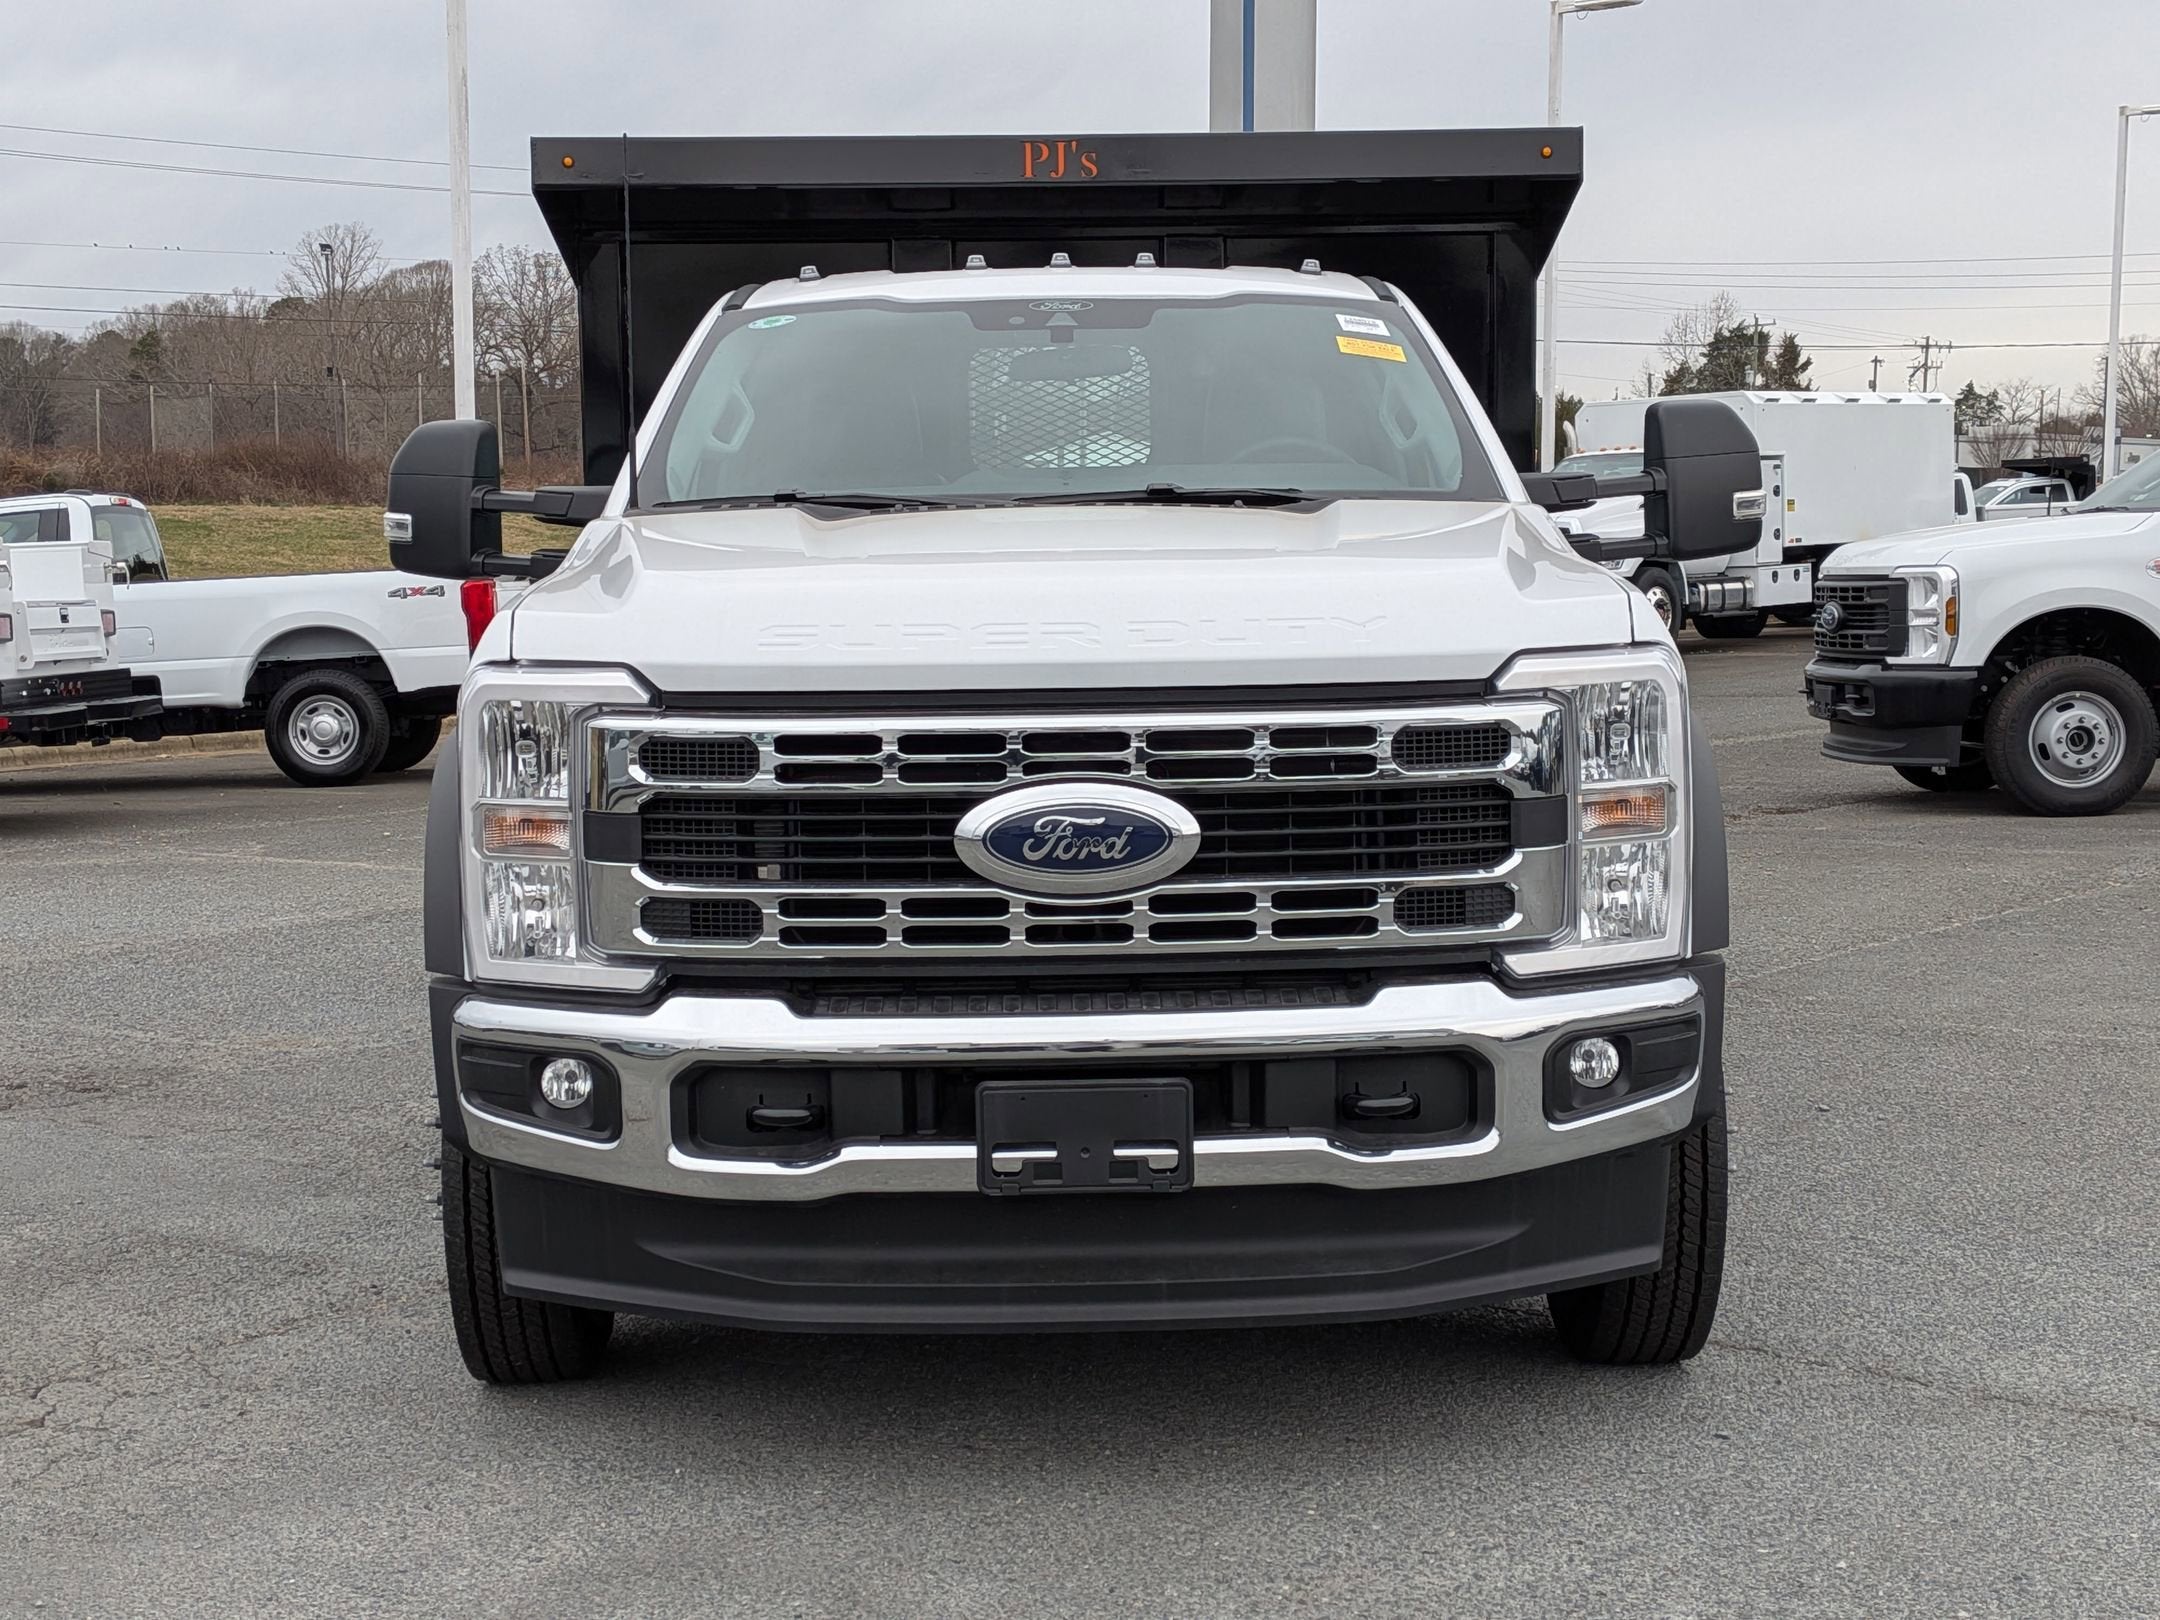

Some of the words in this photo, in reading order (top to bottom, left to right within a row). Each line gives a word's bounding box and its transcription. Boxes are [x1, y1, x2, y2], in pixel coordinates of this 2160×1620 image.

[1021, 140, 1098, 178] PJ's
[757, 622, 1100, 650] SUPER
[1127, 615, 1387, 647] DUTY
[1022, 815, 1134, 861] Ford
